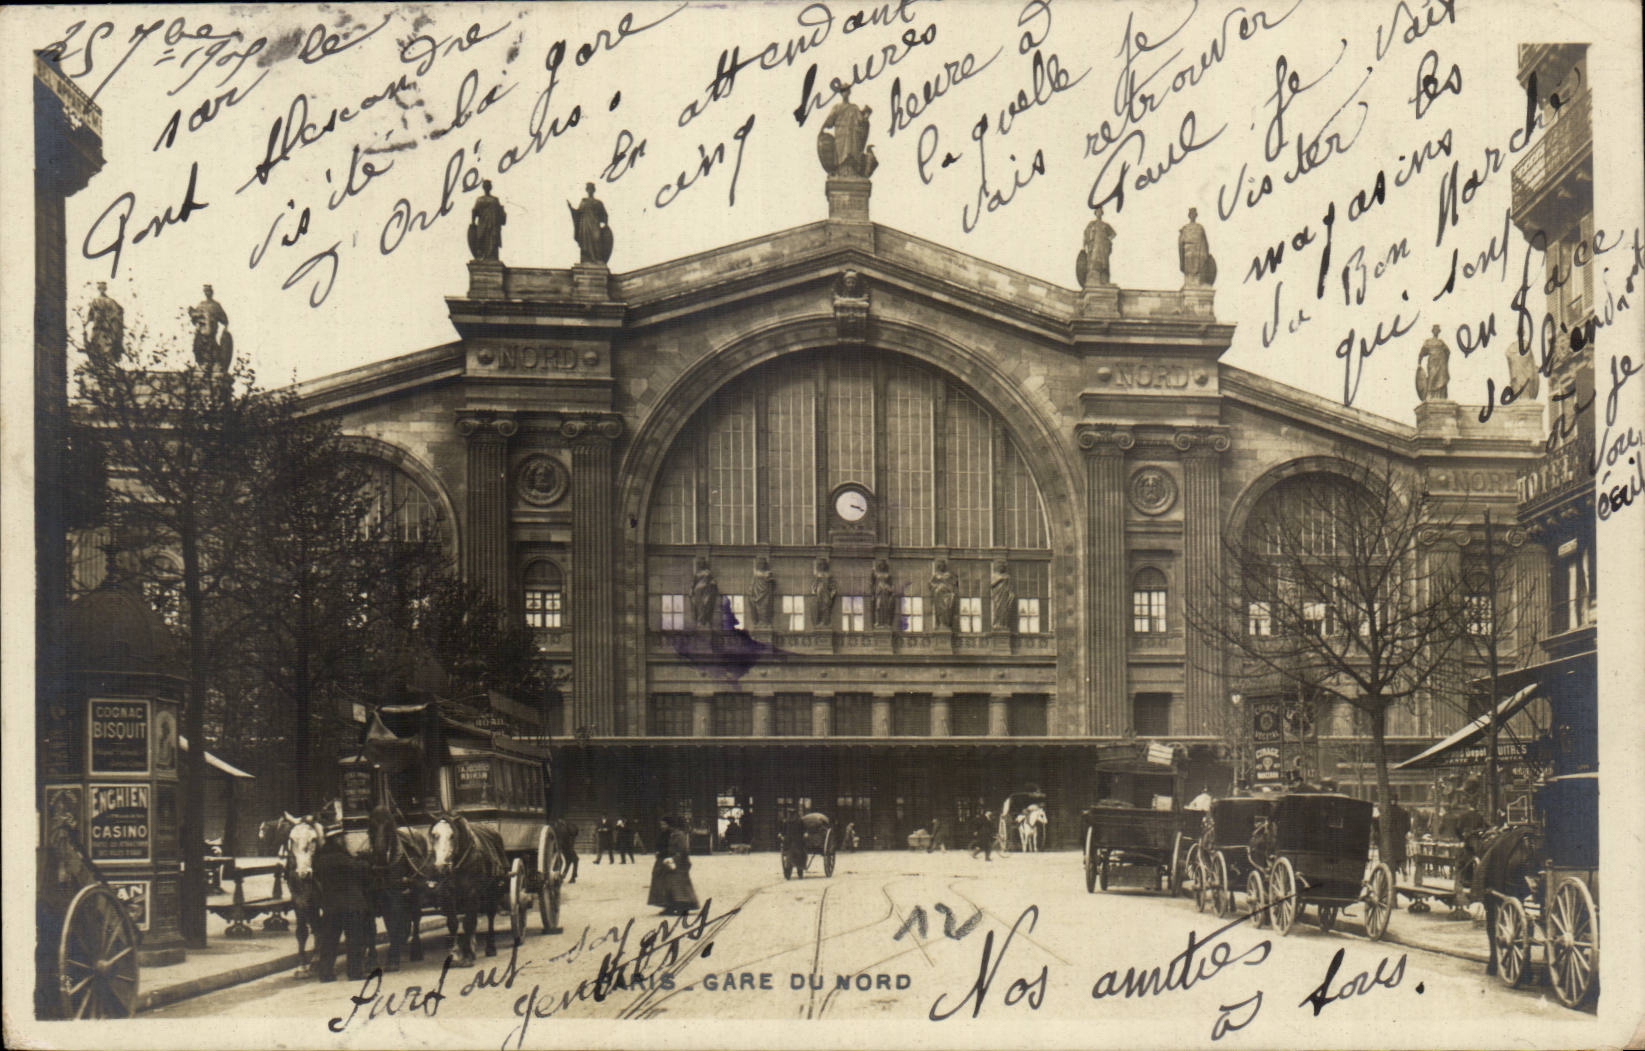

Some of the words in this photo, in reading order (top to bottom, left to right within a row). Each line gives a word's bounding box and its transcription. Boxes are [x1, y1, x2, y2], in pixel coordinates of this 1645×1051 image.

[498, 347, 578, 369] NORD
[1115, 363, 1189, 389] NORD
[96, 706, 144, 718] COGNAC
[93, 721, 147, 740] BISQUIT
[91, 787, 148, 818] ENGHIEN
[91, 825, 148, 838] CASINO
[929, 905, 1048, 1021] Nos
